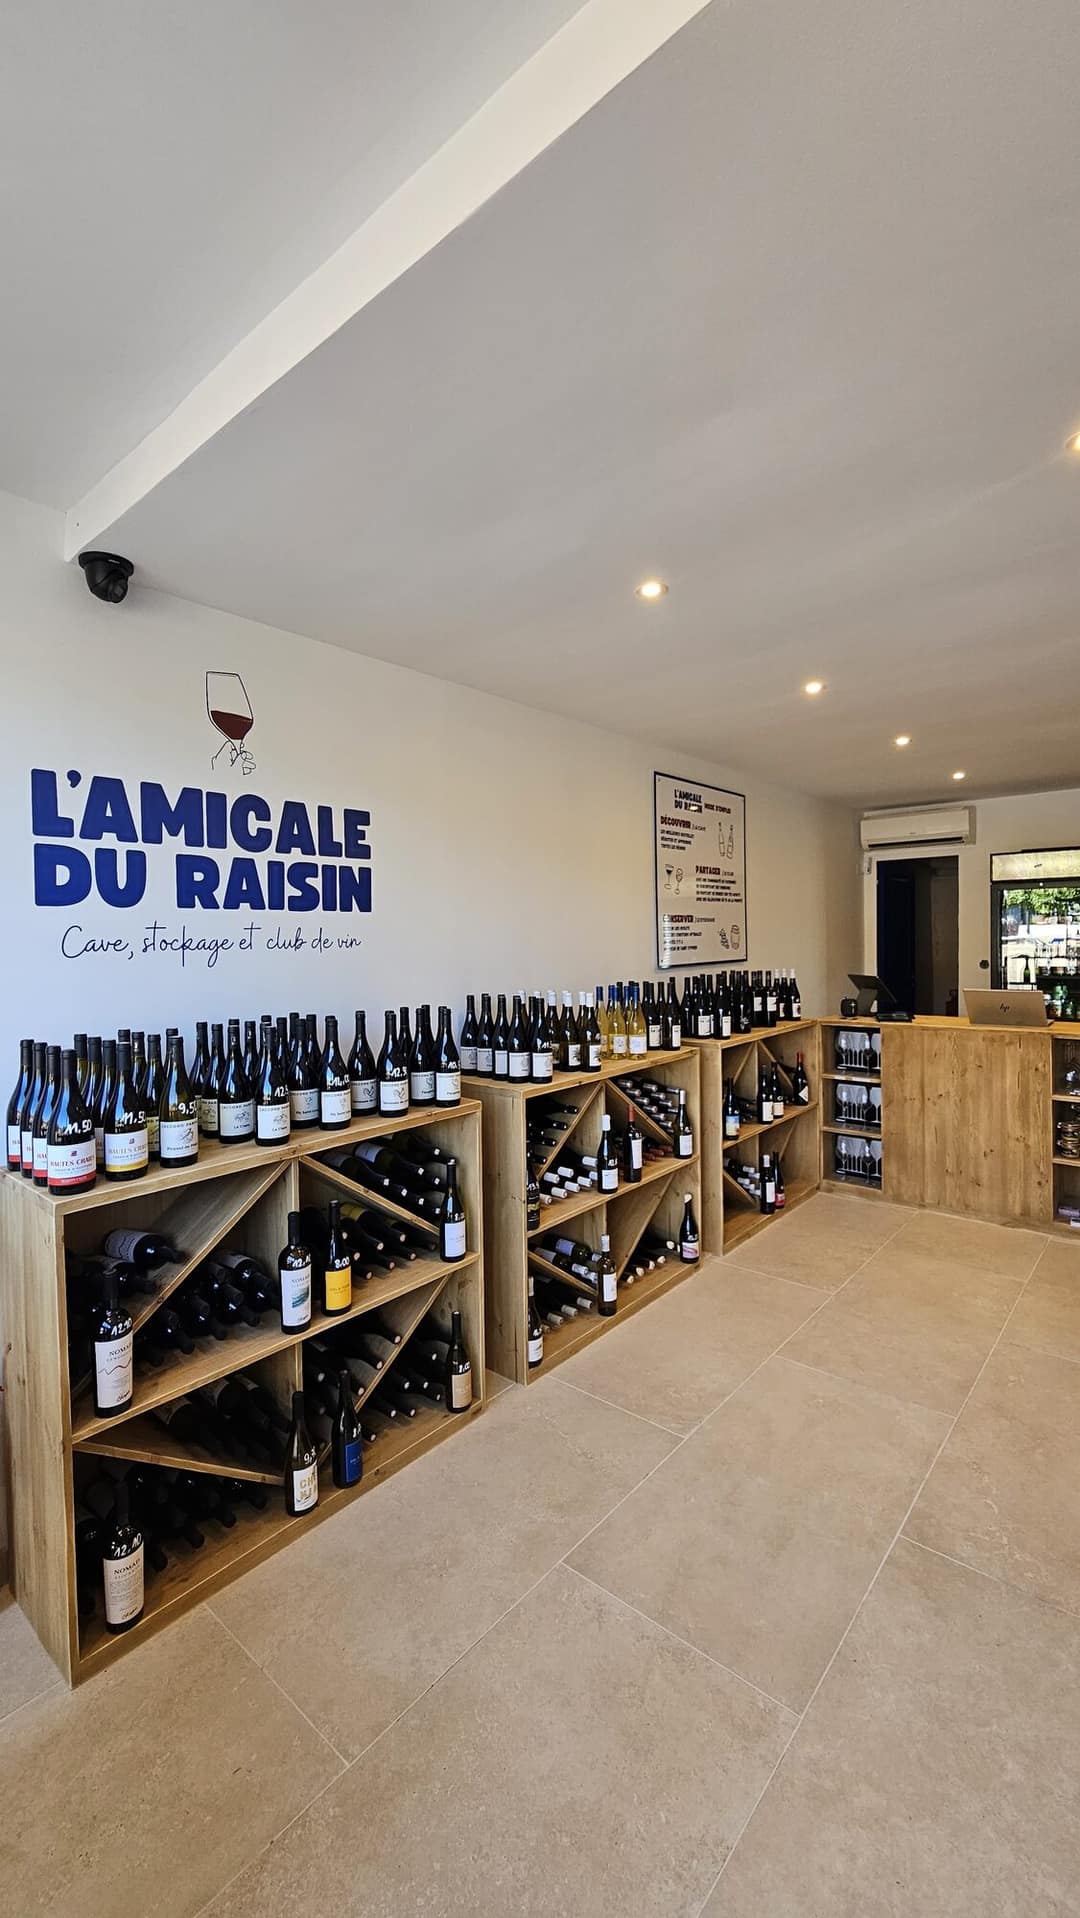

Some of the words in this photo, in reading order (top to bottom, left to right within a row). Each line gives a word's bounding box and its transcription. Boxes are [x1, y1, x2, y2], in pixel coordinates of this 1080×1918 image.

[31, 768, 372, 860] L'AMICALE
[674, 800, 683, 809] DU
[660, 814, 691, 829] DÉCOUVRIR
[34, 843, 147, 908] DU
[176, 854, 373, 913] RAISIN
[695, 865, 721, 875] PARTAGER
[61, 925, 135, 960] Cave,
[142, 920, 234, 968] stockage
[238, 921, 262, 951] et
[266, 927, 307, 953] club
[311, 927, 333, 953] de
[337, 934, 362, 950] vin
